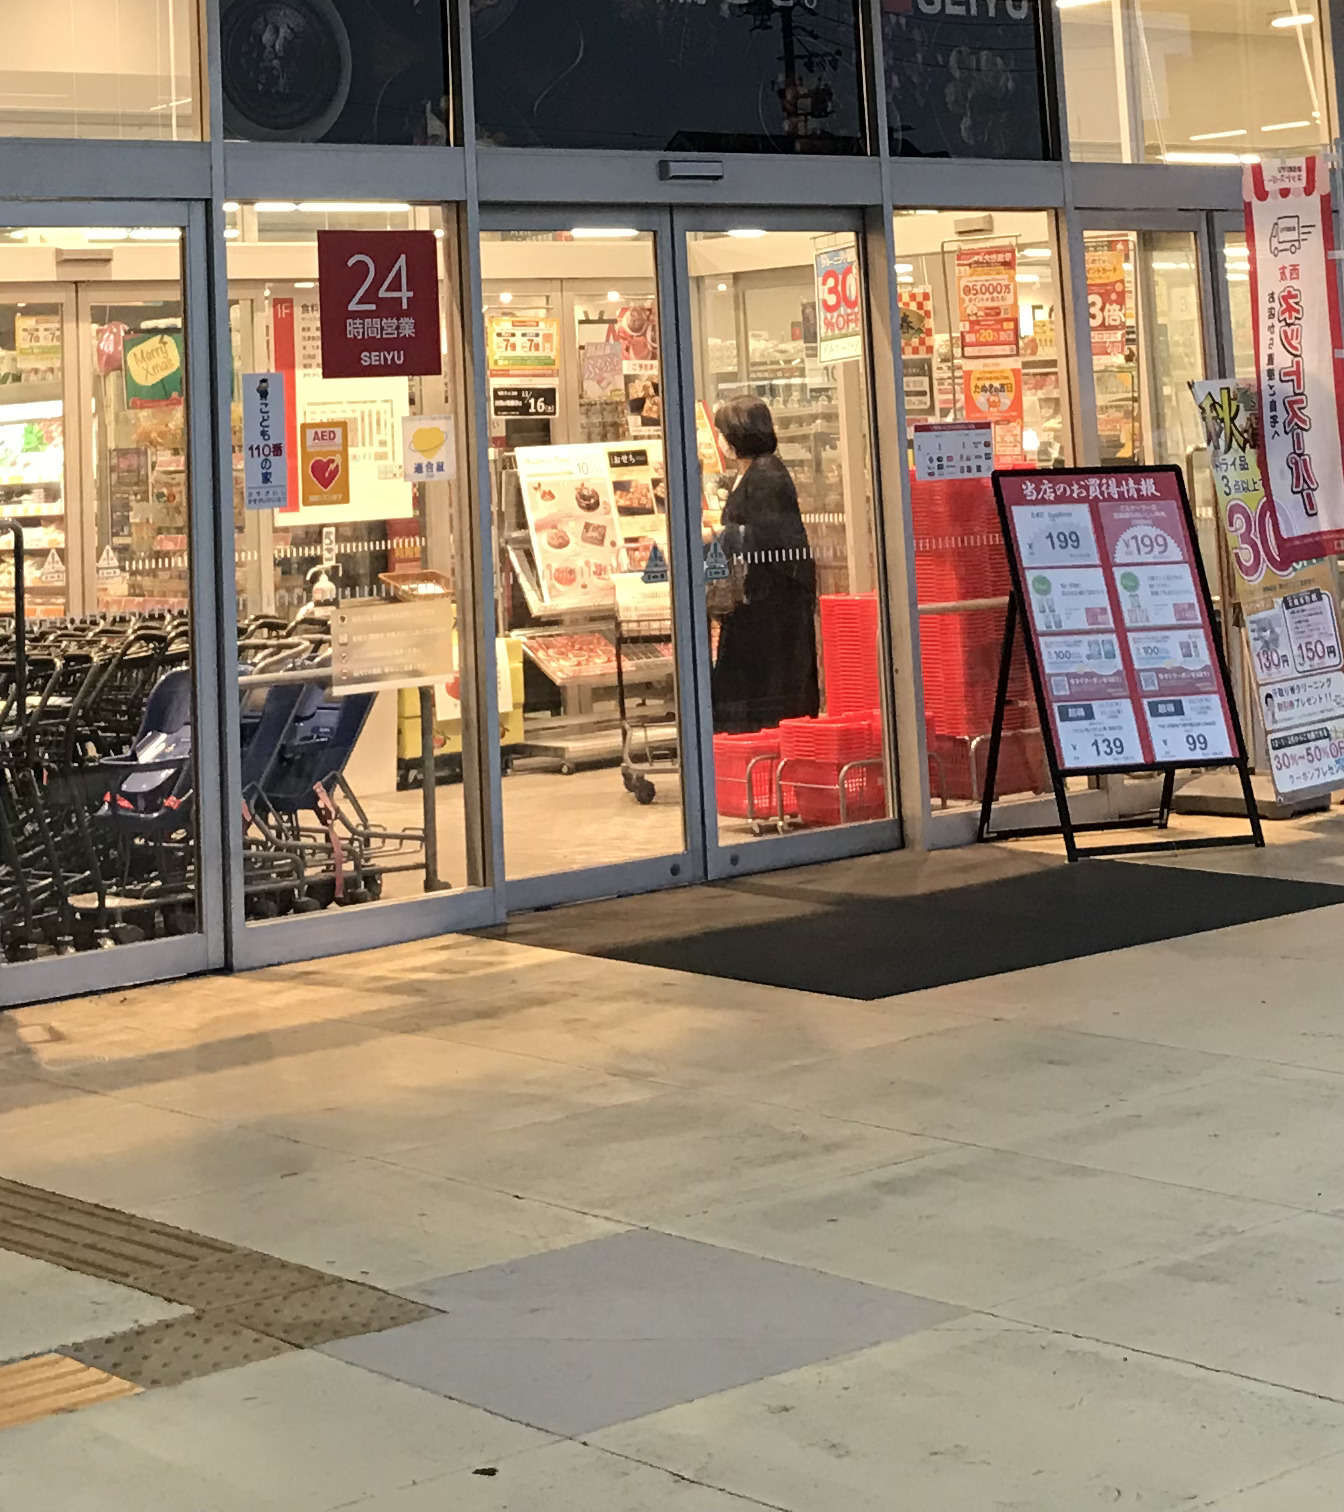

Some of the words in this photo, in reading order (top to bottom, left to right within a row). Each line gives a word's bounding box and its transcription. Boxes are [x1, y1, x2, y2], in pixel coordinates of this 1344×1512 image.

[347, 253, 413, 311] 24
[276, 303, 291, 318] 1F
[346, 317, 416, 339] 時間営業
[361, 350, 404, 365] SEIYU
[313, 430, 336, 442] AED
[1021, 477, 1161, 501] 当店のお買得情報
[1045, 531, 1081, 550] 199
[1297, 639, 1336, 662] 150円
[1091, 737, 1125, 757] 139
[1185, 733, 1209, 752] 99
